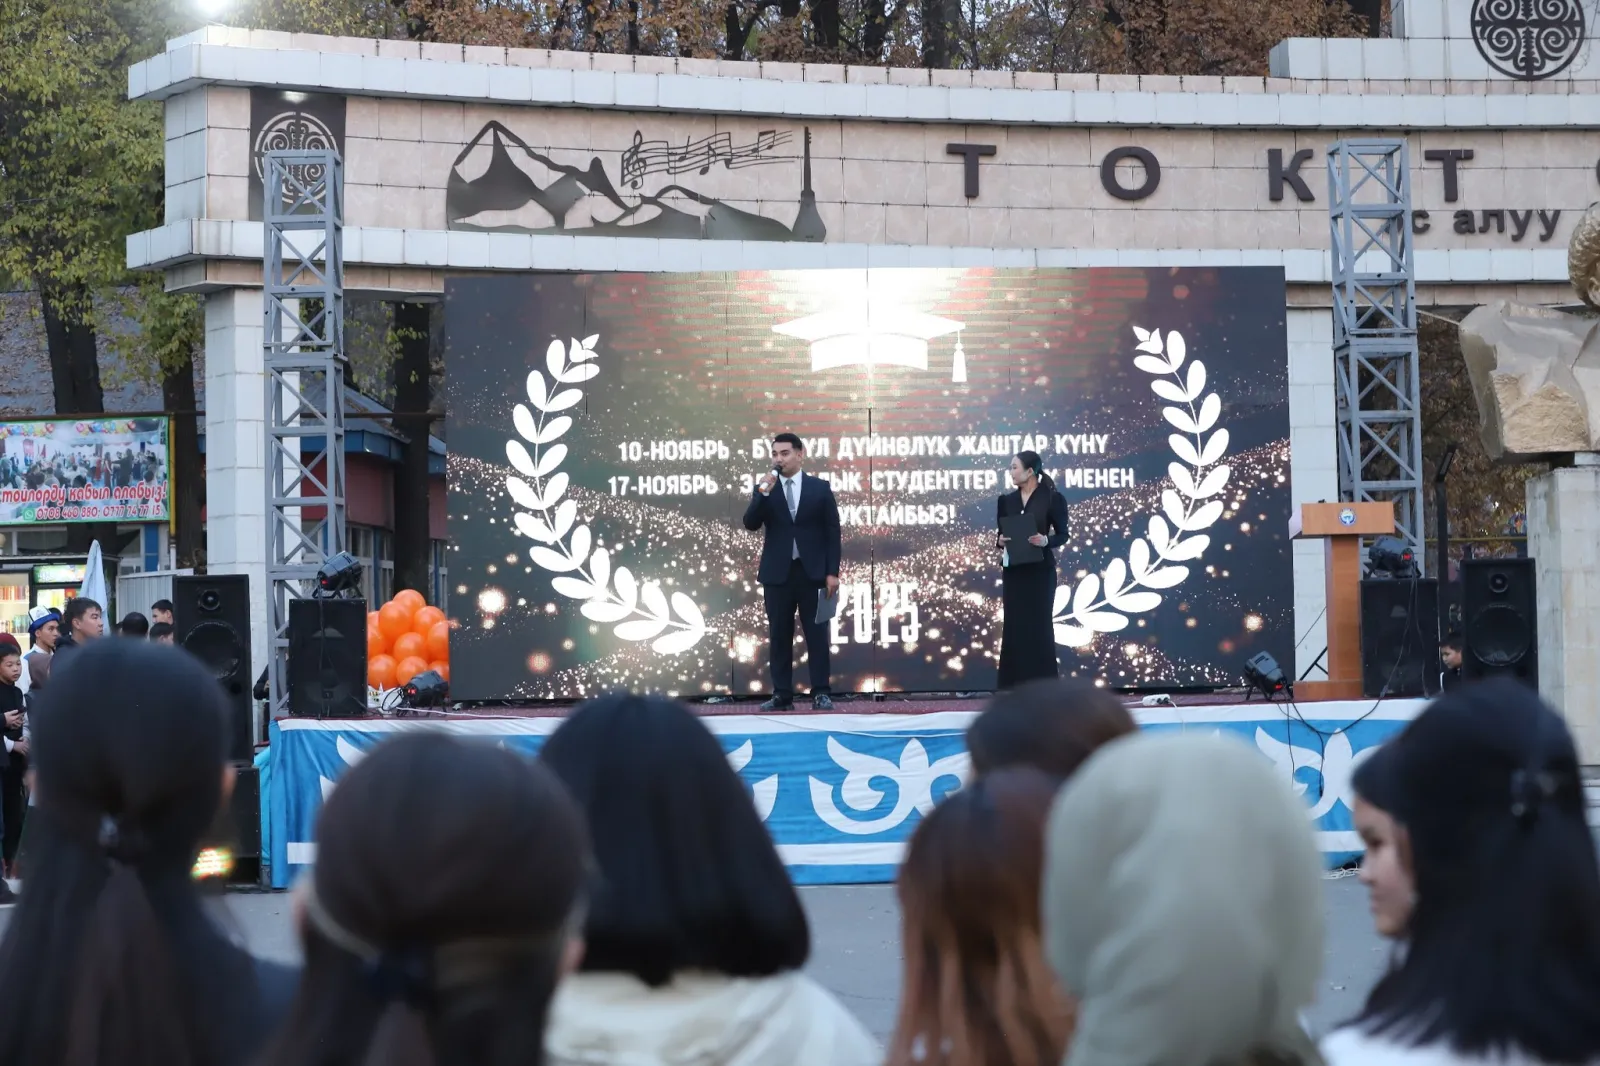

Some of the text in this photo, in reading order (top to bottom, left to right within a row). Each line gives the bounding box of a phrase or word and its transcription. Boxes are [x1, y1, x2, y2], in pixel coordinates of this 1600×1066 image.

[945, 142, 1600, 203] ТОКТ
[1453, 208, 1562, 242] алуу
[618, 439, 730, 462] 10-НОЯБРЬ
[957, 433, 1048, 455] ЖАШТАР
[69, 483, 109, 501] кабыл
[607, 474, 719, 497] 17-НОЯБРЬ
[871, 469, 998, 494] СТУДЕНТТЕР
[1065, 467, 1135, 489] МЕНЕН
[36, 508, 60, 519] 0708
[830, 582, 919, 644] 2025
